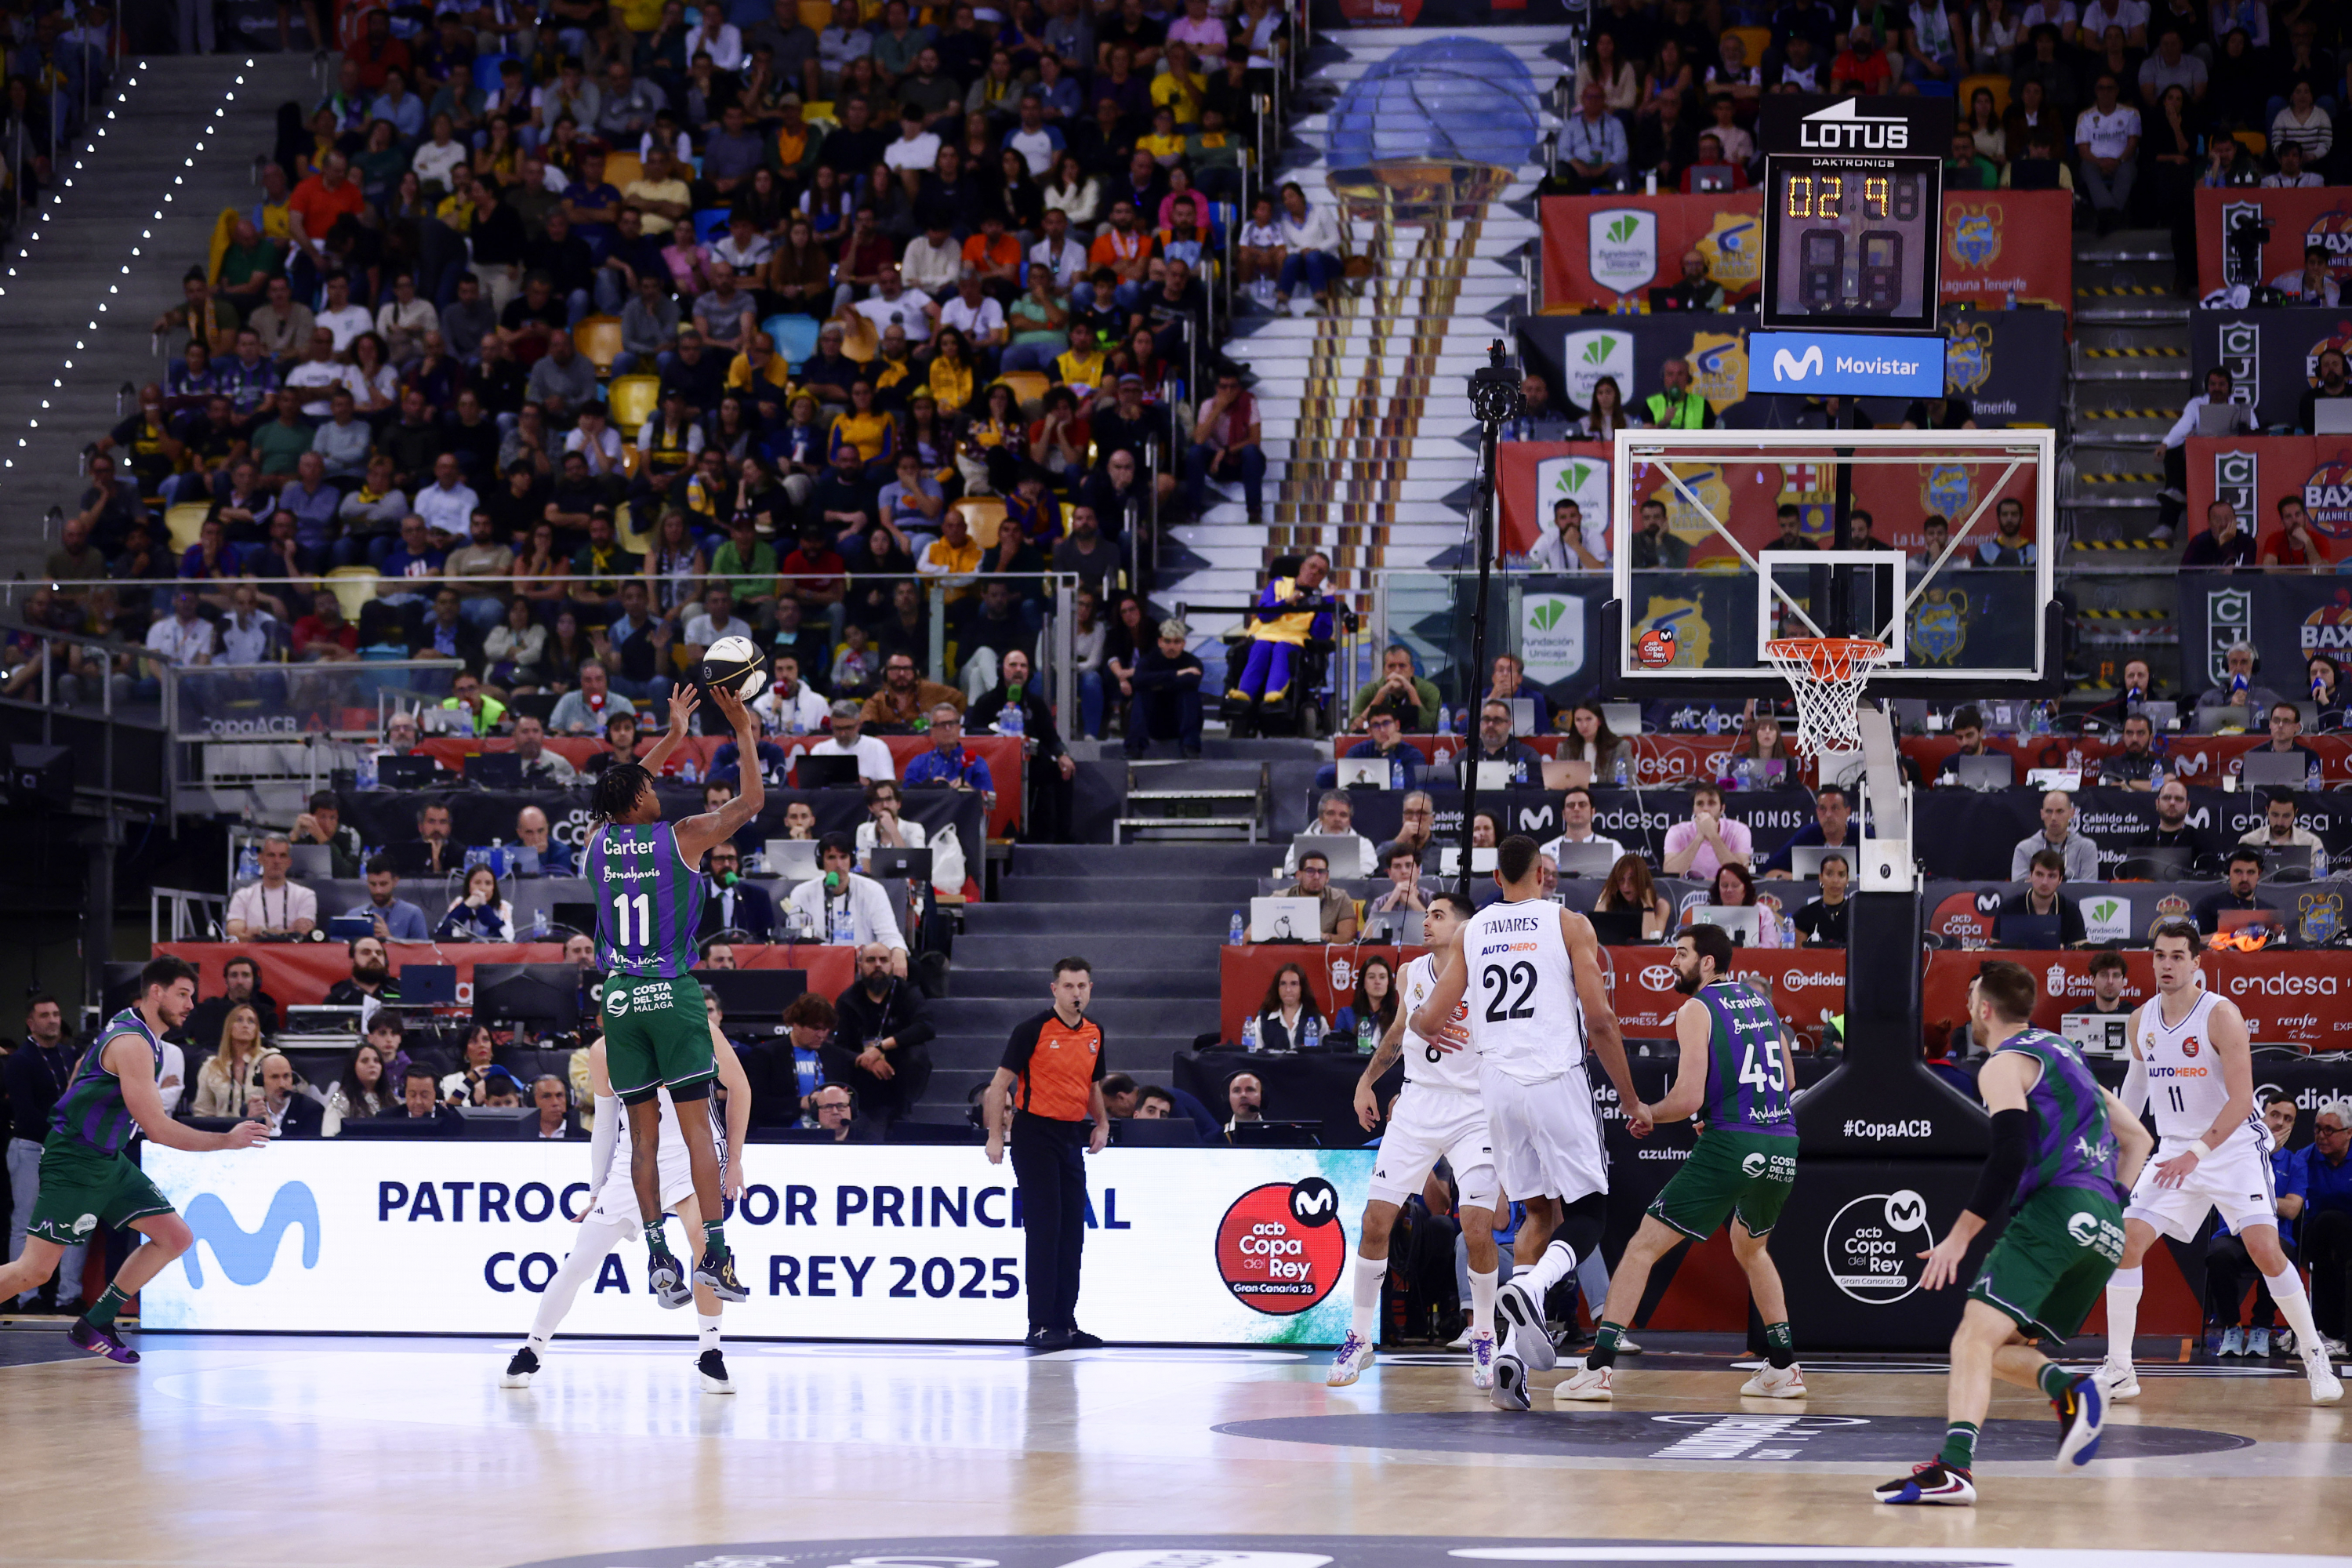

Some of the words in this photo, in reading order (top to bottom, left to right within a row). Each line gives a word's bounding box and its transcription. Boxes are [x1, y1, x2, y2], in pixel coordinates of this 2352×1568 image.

[1801, 123, 1908, 148] LOTUS
[1812, 158, 1895, 168] DAKTRONICS
[1940, 278, 1980, 292] Laguna
[1984, 278, 2027, 291] Tenerife
[1836, 357, 1919, 376] Movistar
[1972, 400, 2017, 415] Tenerife
[1893, 532, 1911, 546] La
[1529, 648, 1566, 659] Unicaja
[1635, 753, 1684, 774] esa
[1592, 808, 1669, 829] ndesa
[1748, 811, 1801, 828] IONOS
[2082, 813, 2122, 823] Cabildo
[2125, 813, 2138, 823] de
[2232, 813, 2329, 832] ensa
[2082, 824, 2107, 833] Gran
[2110, 823, 2150, 834] Canaria
[603, 837, 656, 855] Carter
[613, 893, 650, 946] 11
[1483, 917, 1539, 935] TAVARES
[1951, 913, 1972, 923] acb
[1943, 922, 1982, 939] Copa
[2086, 926, 2124, 935] Fundación
[1481, 942, 1537, 956] AUTOHERO
[633, 982, 673, 996] COSTA
[1483, 960, 1538, 1023] 22
[2067, 985, 2094, 997] Gran
[2230, 971, 2336, 996] endesa
[633, 993, 652, 1005] DEL
[653, 990, 673, 1002] SOL
[633, 999, 673, 1013] MÁLAGA
[1719, 993, 1766, 1010] Kravish
[2277, 1013, 2318, 1029] renfe
[1738, 1040, 1785, 1093] 45
[2149, 1067, 2208, 1078] AUTOHERO
[1593, 1084, 1618, 1102] de
[2168, 1086, 2184, 1112] 11
[1843, 1120, 1932, 1141] #CopaACB
[1769, 1166, 1784, 1175] DEL
[379, 1181, 817, 1225] PATROCOR
[837, 1185, 1131, 1229] PRINCIL
[1252, 1221, 1286, 1236] acb
[1855, 1226, 1882, 1239] acb
[1239, 1235, 1302, 1258] Copa
[1845, 1238, 1896, 1256] Copa
[1269, 1258, 1312, 1282] Rey
[1848, 1256, 1866, 1266] del
[1869, 1257, 1904, 1276] Rey
[485, 1252, 630, 1294] COA
[769, 1254, 876, 1297] REY
[889, 1256, 1019, 1299] 2025
[1840, 1277, 1858, 1286] Gran
[1860, 1277, 1893, 1286] Canaria
[1233, 1283, 1258, 1294] Gran
[1259, 1283, 1299, 1294] Canaria
